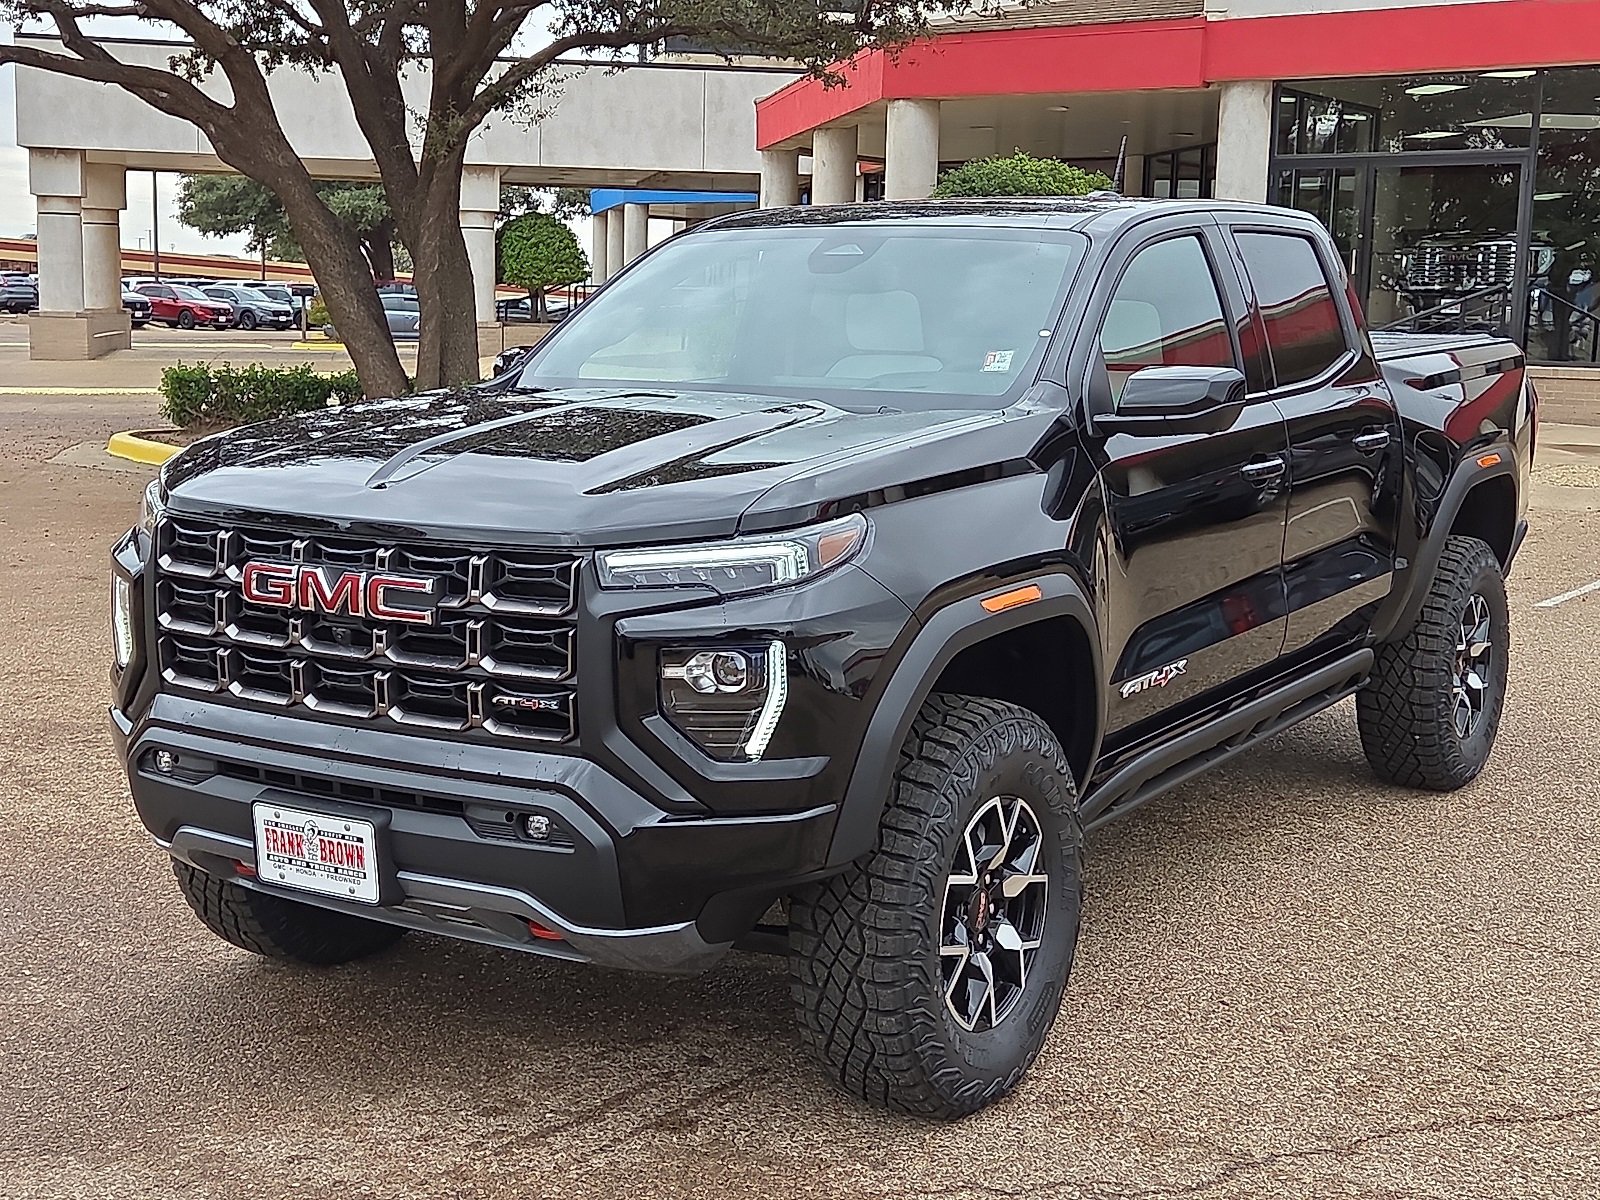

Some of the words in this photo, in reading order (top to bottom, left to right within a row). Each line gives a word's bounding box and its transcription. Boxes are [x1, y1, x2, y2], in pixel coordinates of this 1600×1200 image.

[242, 561, 435, 626] GMC
[1119, 659, 1188, 699] AT4X
[491, 695, 559, 710] AT4X
[264, 828, 305, 859] FRANK
[319, 838, 365, 870] BROWN
[268, 854, 290, 864] AUTO
[291, 859, 307, 868] AND
[308, 862, 335, 873] TRUCK
[337, 868, 364, 879] RANCH
[272, 862, 286, 871] GMC
[295, 867, 317, 878] HONDA
[326, 873, 361, 886] PREOWNED
